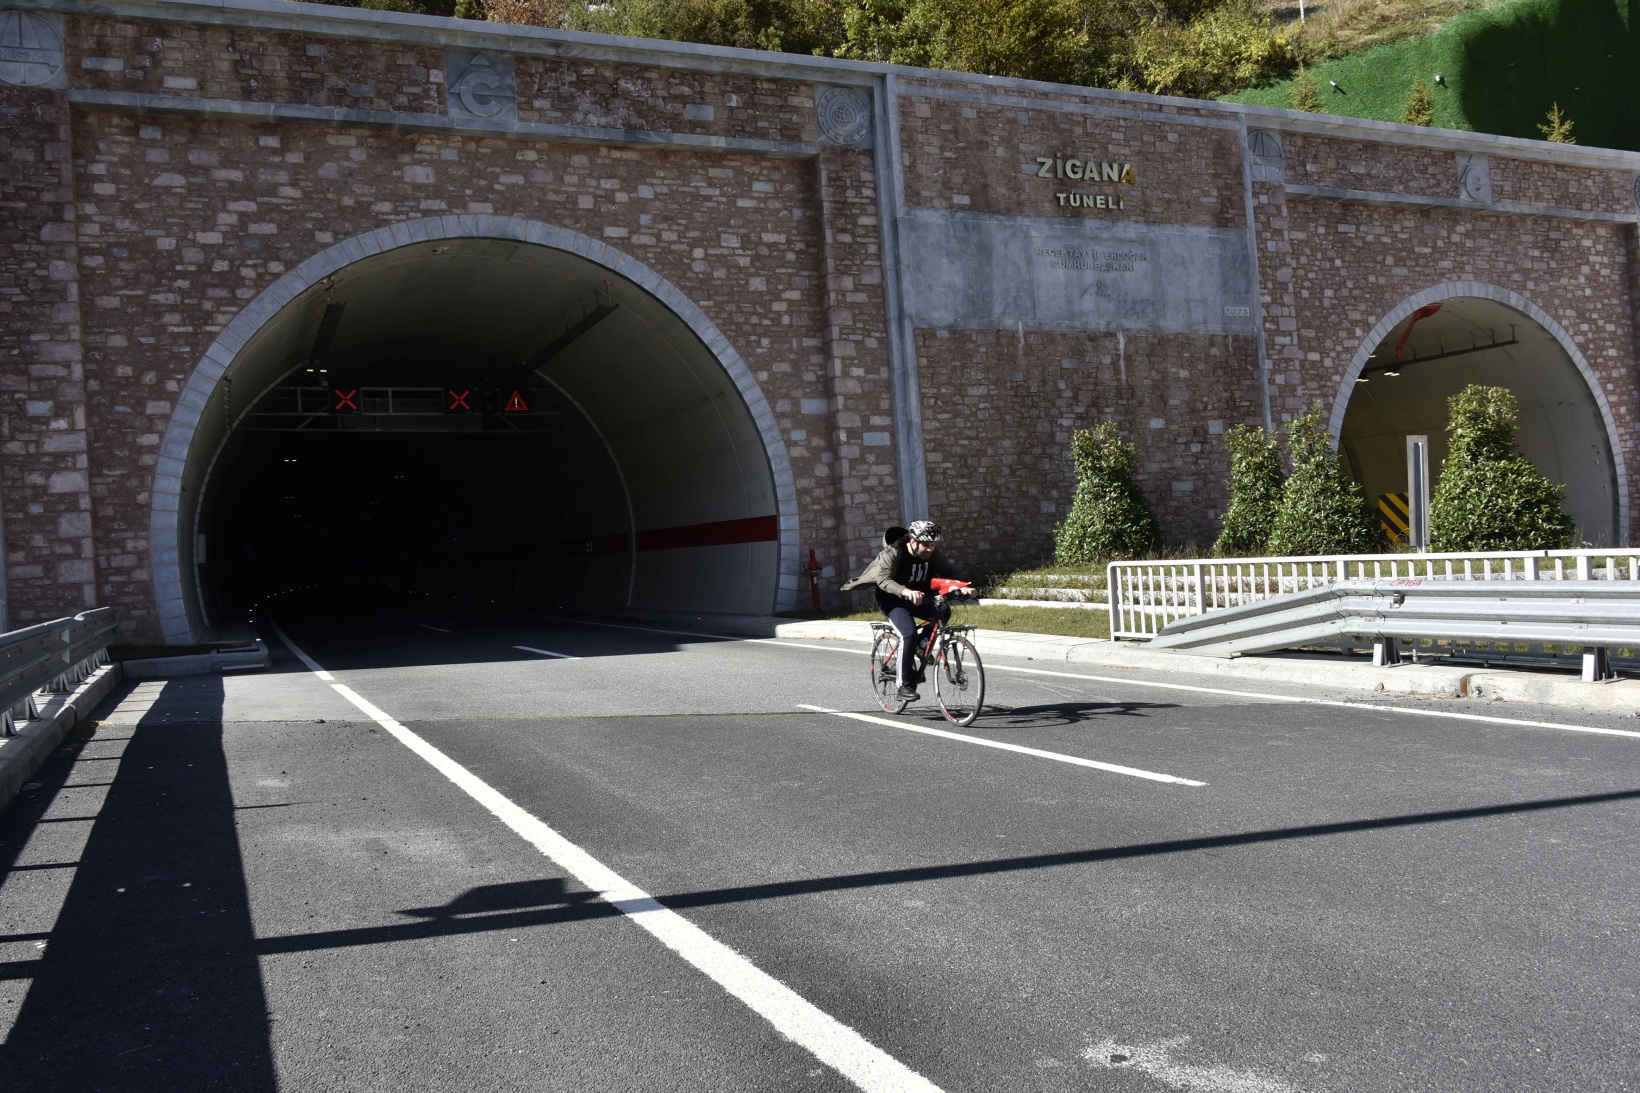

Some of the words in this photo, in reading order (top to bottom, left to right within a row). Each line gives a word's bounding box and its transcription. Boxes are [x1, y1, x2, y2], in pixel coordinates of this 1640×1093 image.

[1036, 151, 1137, 185] ZİGANA
[1056, 191, 1125, 210] TÜNELİ
[1035, 247, 1067, 257] RECEP
[1067, 247, 1103, 260] TAYYİP
[1105, 249, 1148, 261] ERDOĞAN
[1051, 259, 1135, 273] CUMHURBAŞKANI
[1224, 306, 1250, 317] 2023
